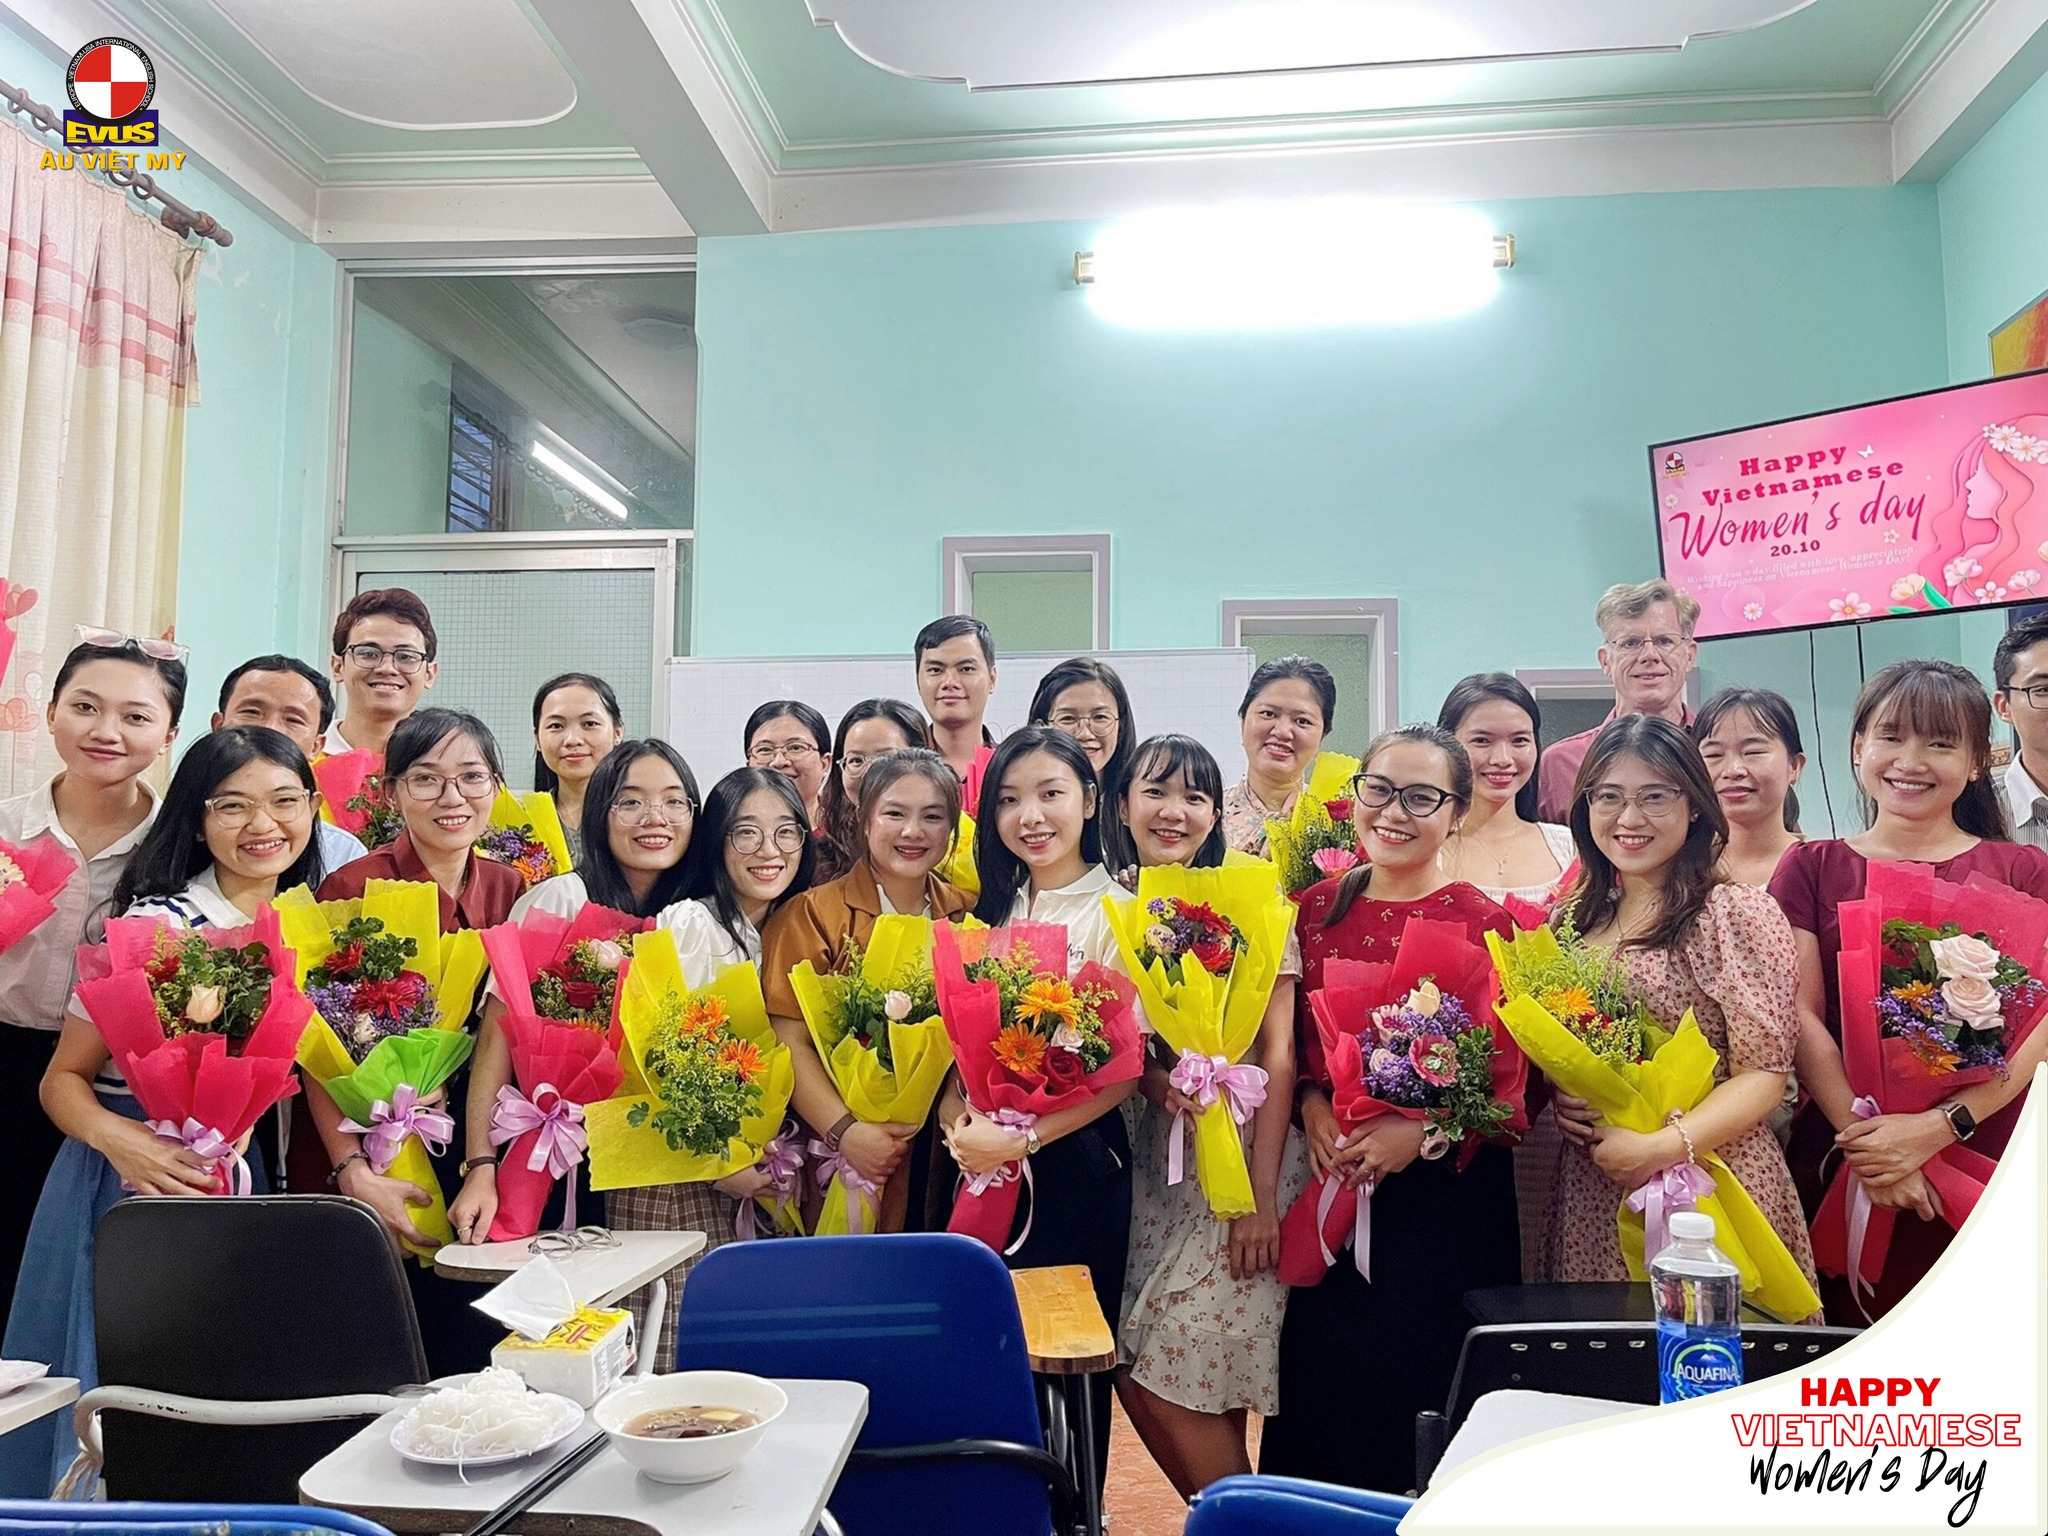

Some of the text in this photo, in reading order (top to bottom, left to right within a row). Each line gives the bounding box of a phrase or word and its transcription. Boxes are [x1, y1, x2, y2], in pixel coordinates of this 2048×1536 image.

[1739, 444, 1848, 478] Happy
[1702, 459, 1905, 507] Vietnamese
[1668, 480, 1926, 561] Women's day
[1770, 539, 1821, 558] 20.10
[1726, 570, 1742, 579] you
[1752, 566, 1769, 577] day
[1799, 557, 1822, 568] with
[1780, 566, 1836, 579] Vietnamese
[1677, 1362, 1737, 1384] AQUAFINA
